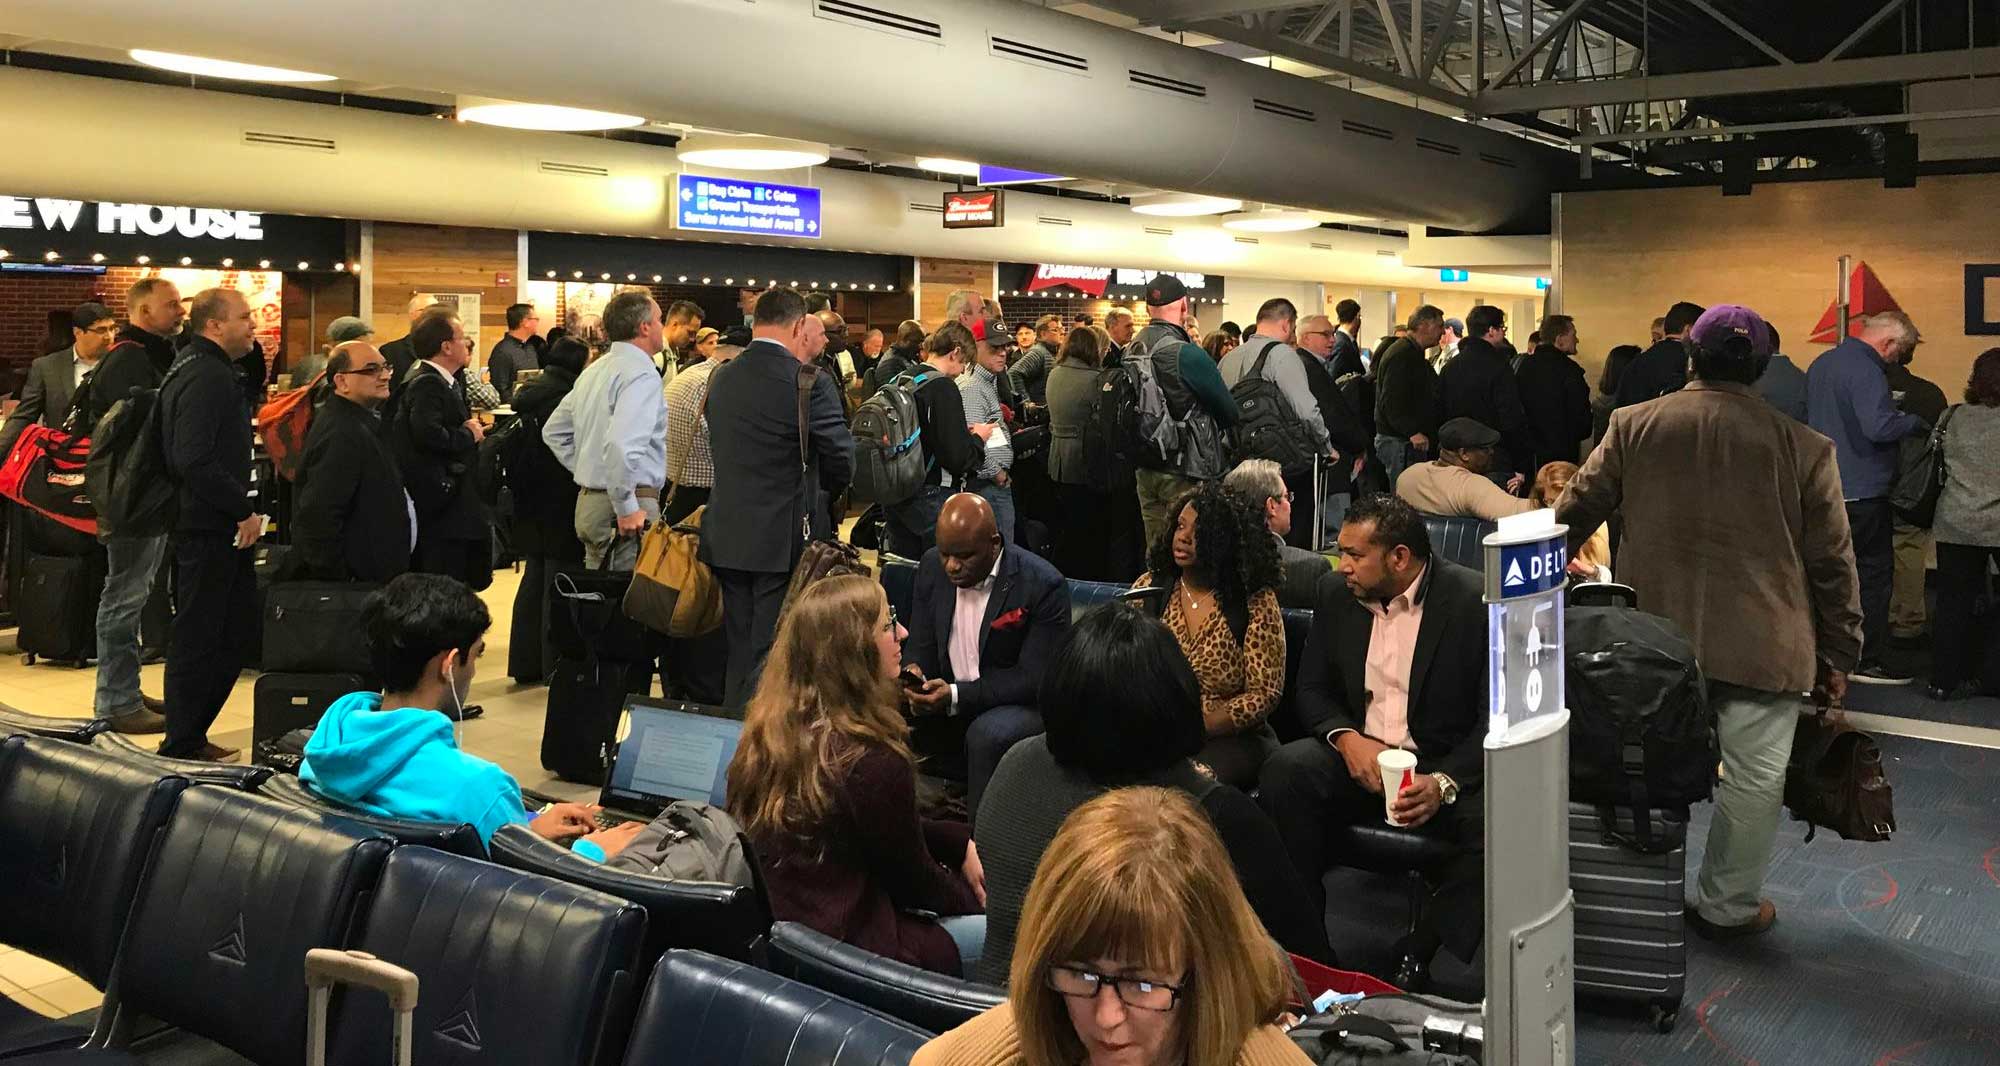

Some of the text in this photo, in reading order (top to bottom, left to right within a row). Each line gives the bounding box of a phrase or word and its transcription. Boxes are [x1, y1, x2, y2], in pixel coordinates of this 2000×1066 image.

[98, 202, 264, 240] HOUSE
[742, 200, 800, 217] Transportation
[1531, 547, 1565, 580] DELT
